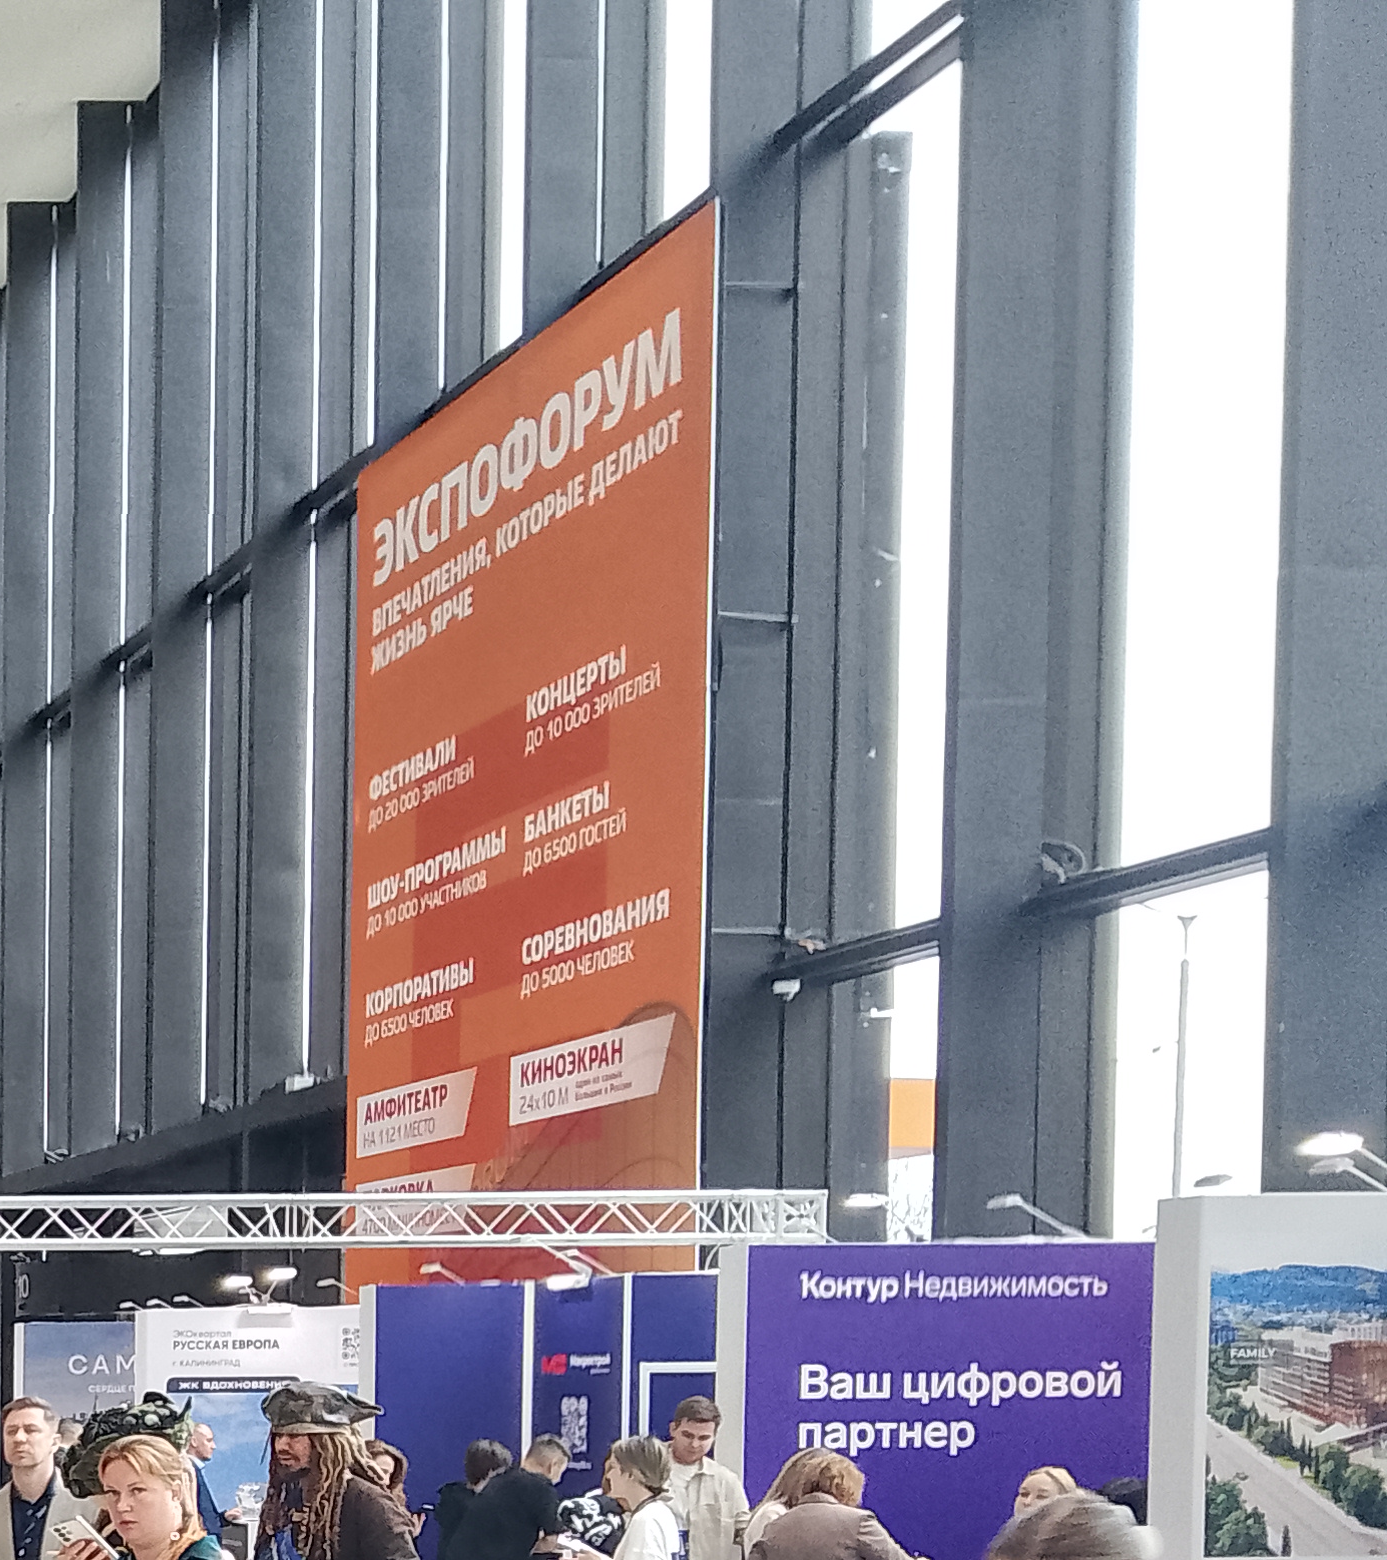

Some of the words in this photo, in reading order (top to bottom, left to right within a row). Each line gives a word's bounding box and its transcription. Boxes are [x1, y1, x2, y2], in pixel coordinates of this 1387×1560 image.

[373, 307, 683, 587] ЭКСПОФОРУМ
[372, 537, 491, 637] ВПЕЧАТЛЕНИЯ,
[495, 472, 586, 557] КОТОРЫЕ
[588, 409, 684, 506] ДЕЛАЮТ
[370, 617, 427, 677] ЖИЗНЬ
[430, 585, 475, 637] ЯРЧЕ
[524, 727, 544, 757] ДО
[547, 716, 563, 740] 10
[565, 704, 590, 733] 000
[592, 661, 661, 719] ЗРИТЕЛЕЙ
[525, 643, 627, 723] КОНЦЕРТЫ
[368, 806, 384, 833] ДО
[384, 800, 398, 820] 20
[421, 756, 475, 804] ЗРИТЕЛЕЙ
[369, 734, 457, 800] ФЕСТИВАЛИ
[522, 847, 542, 877] ДО
[543, 834, 577, 864] 6500
[579, 807, 627, 850] ГОСТЕЙ
[523, 780, 611, 843] БАНКЕТЫ
[367, 826, 507, 910] ШОУ-ПРОГРАММЫ
[366, 912, 382, 939] ДО
[384, 906, 396, 927] 10
[419, 869, 487, 914] УЧАСТНИКОВ
[521, 887, 671, 966] СОРЕВНОВАНИЯ
[365, 957, 474, 1018] КОРПОРАТИВЫ
[520, 972, 539, 1000] ДО
[541, 961, 574, 990] 5000
[577, 939, 635, 977] ЧЕЛОВЕК
[364, 1024, 380, 1048] ДО
[381, 1013, 407, 1039] 6500
[408, 997, 454, 1031] ЧЕЛОВЕК
[520, 1037, 623, 1088] КИНОЭКРАН
[363, 1084, 448, 1126] АМФИТЕАТР
[363, 1131, 376, 1149] НА
[403, 1117, 436, 1141] МЕСТО
[799, 1270, 900, 1303] Контур
[904, 1269, 1109, 1303] Недвижимость
[172, 1339, 228, 1351] РУССКАЯ
[231, 1339, 280, 1350] ЕВРОПА
[180, 1359, 241, 1368] КАЛИНИНГРАД
[1230, 1347, 1277, 1359] FAMILY
[87, 1384, 127, 1394] СЕРДЦЕ
[178, 1381, 199, 1390] ЖК
[798, 1363, 892, 1400] Ваш
[902, 1360, 1122, 1406] цифровой
[798, 1419, 976, 1456] партнер
